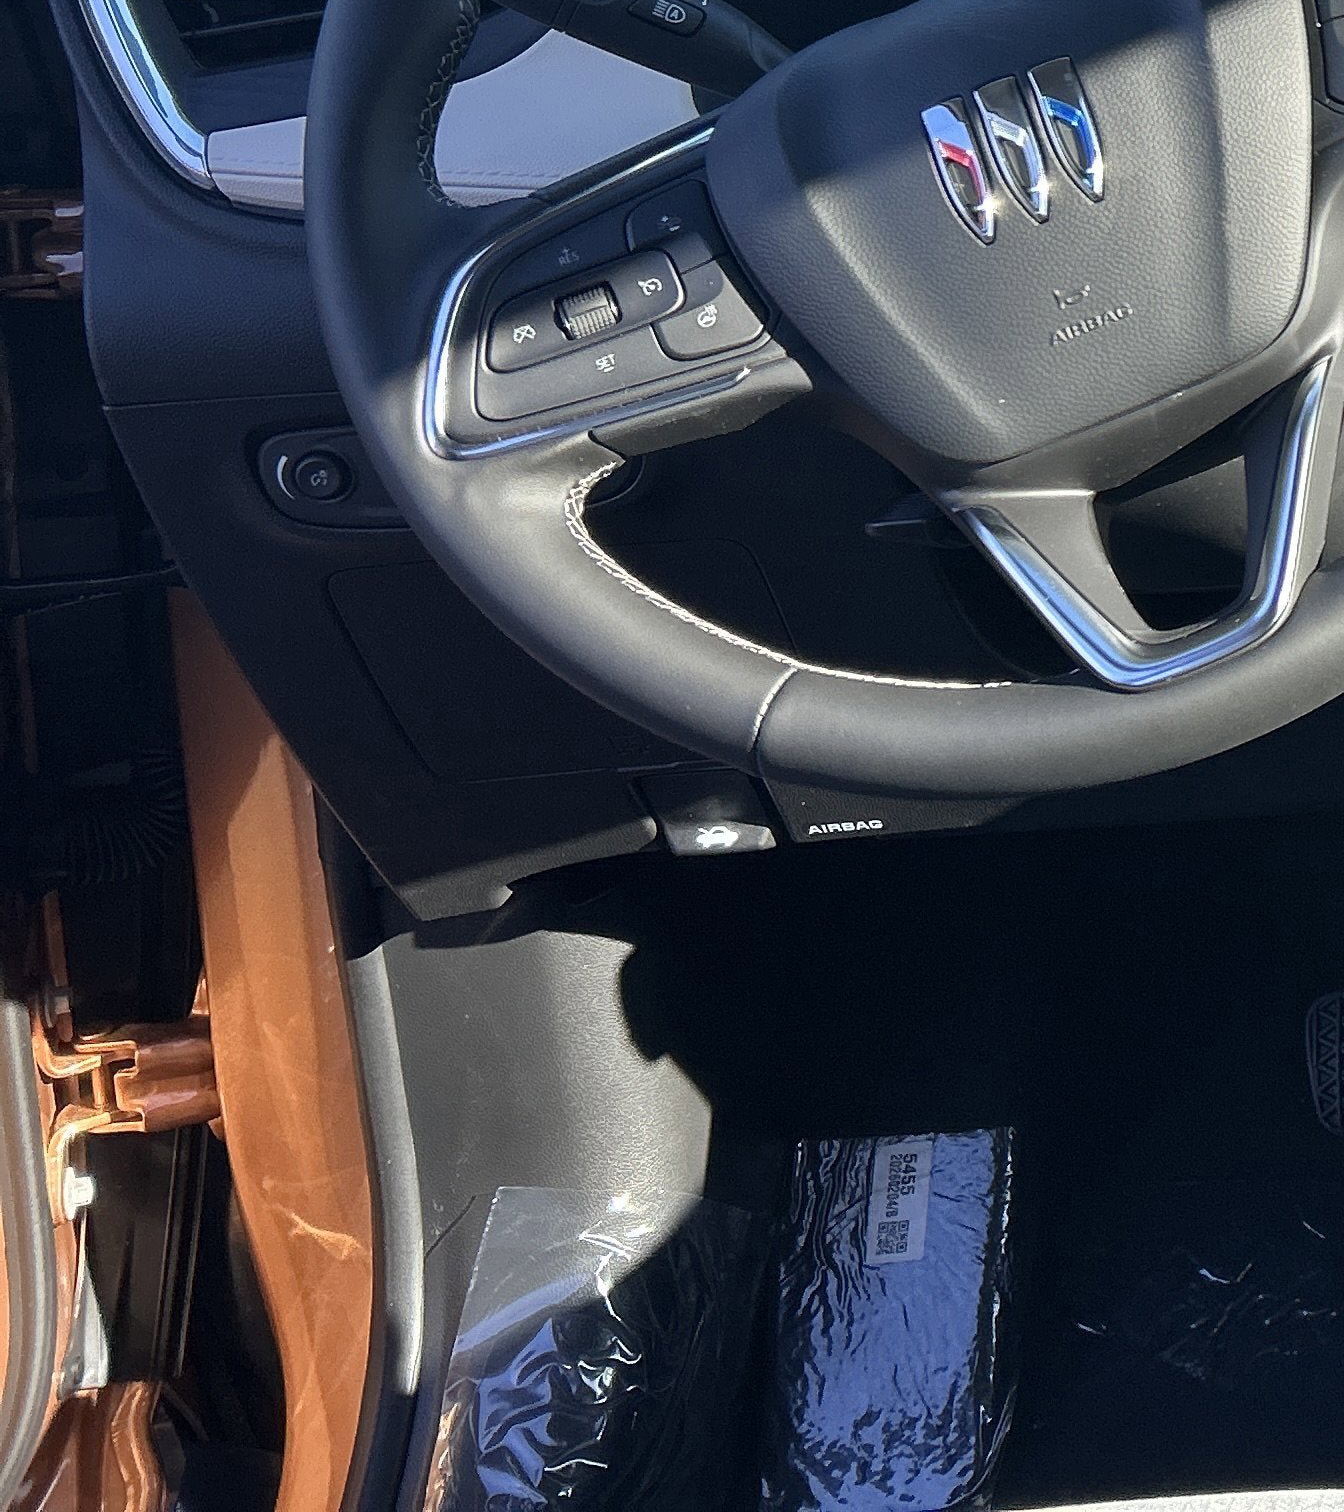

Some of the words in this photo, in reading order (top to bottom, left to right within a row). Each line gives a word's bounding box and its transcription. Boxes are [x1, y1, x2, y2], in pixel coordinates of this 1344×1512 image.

[595, 353, 616, 369] SET
[808, 819, 884, 835] AIRBAG
[900, 1153, 918, 1196] 5455
